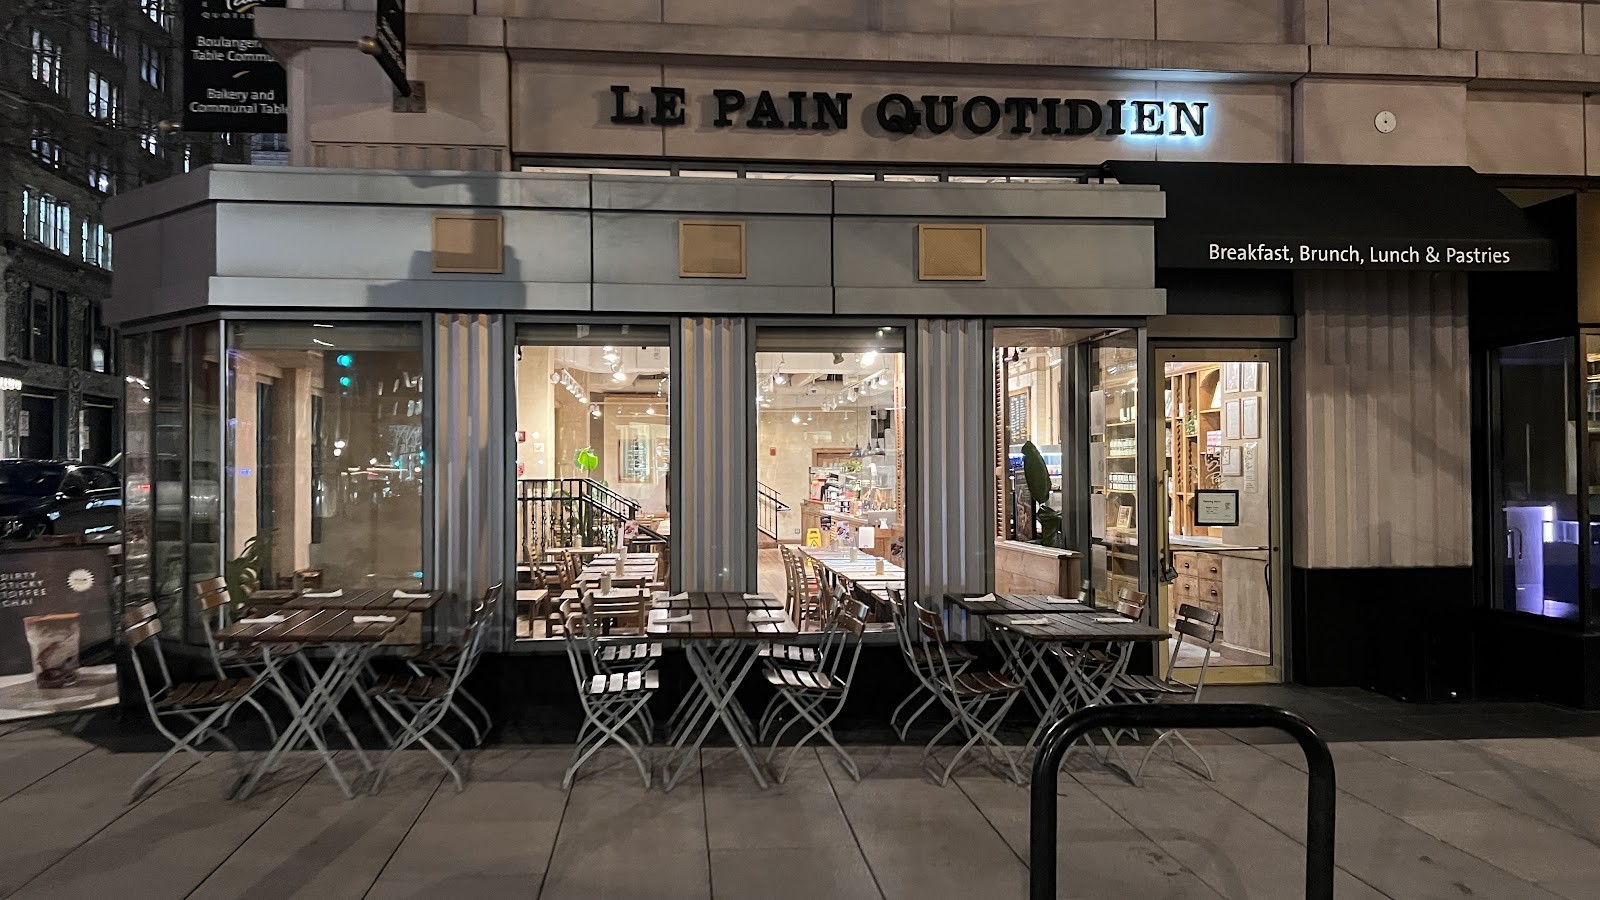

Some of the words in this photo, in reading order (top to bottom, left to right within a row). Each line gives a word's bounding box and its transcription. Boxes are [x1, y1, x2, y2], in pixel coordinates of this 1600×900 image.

[197, 36, 261, 51] Boulanger
[190, 49, 225, 61] Table
[227, 50, 275, 62] Commu
[206, 88, 248, 103] Bakery
[250, 89, 275, 101] and
[188, 102, 258, 114] Communal
[610, 85, 686, 126] LE
[713, 88, 852, 130] PAIN
[876, 93, 1209, 137] QUOTIDIEN
[1209, 244, 1294, 263] Breakfast,
[1300, 245, 1364, 265] Brunch,
[1370, 247, 1420, 263] Lunch
[1425, 246, 1440, 263] &
[1446, 247, 1511, 264] Pastries
